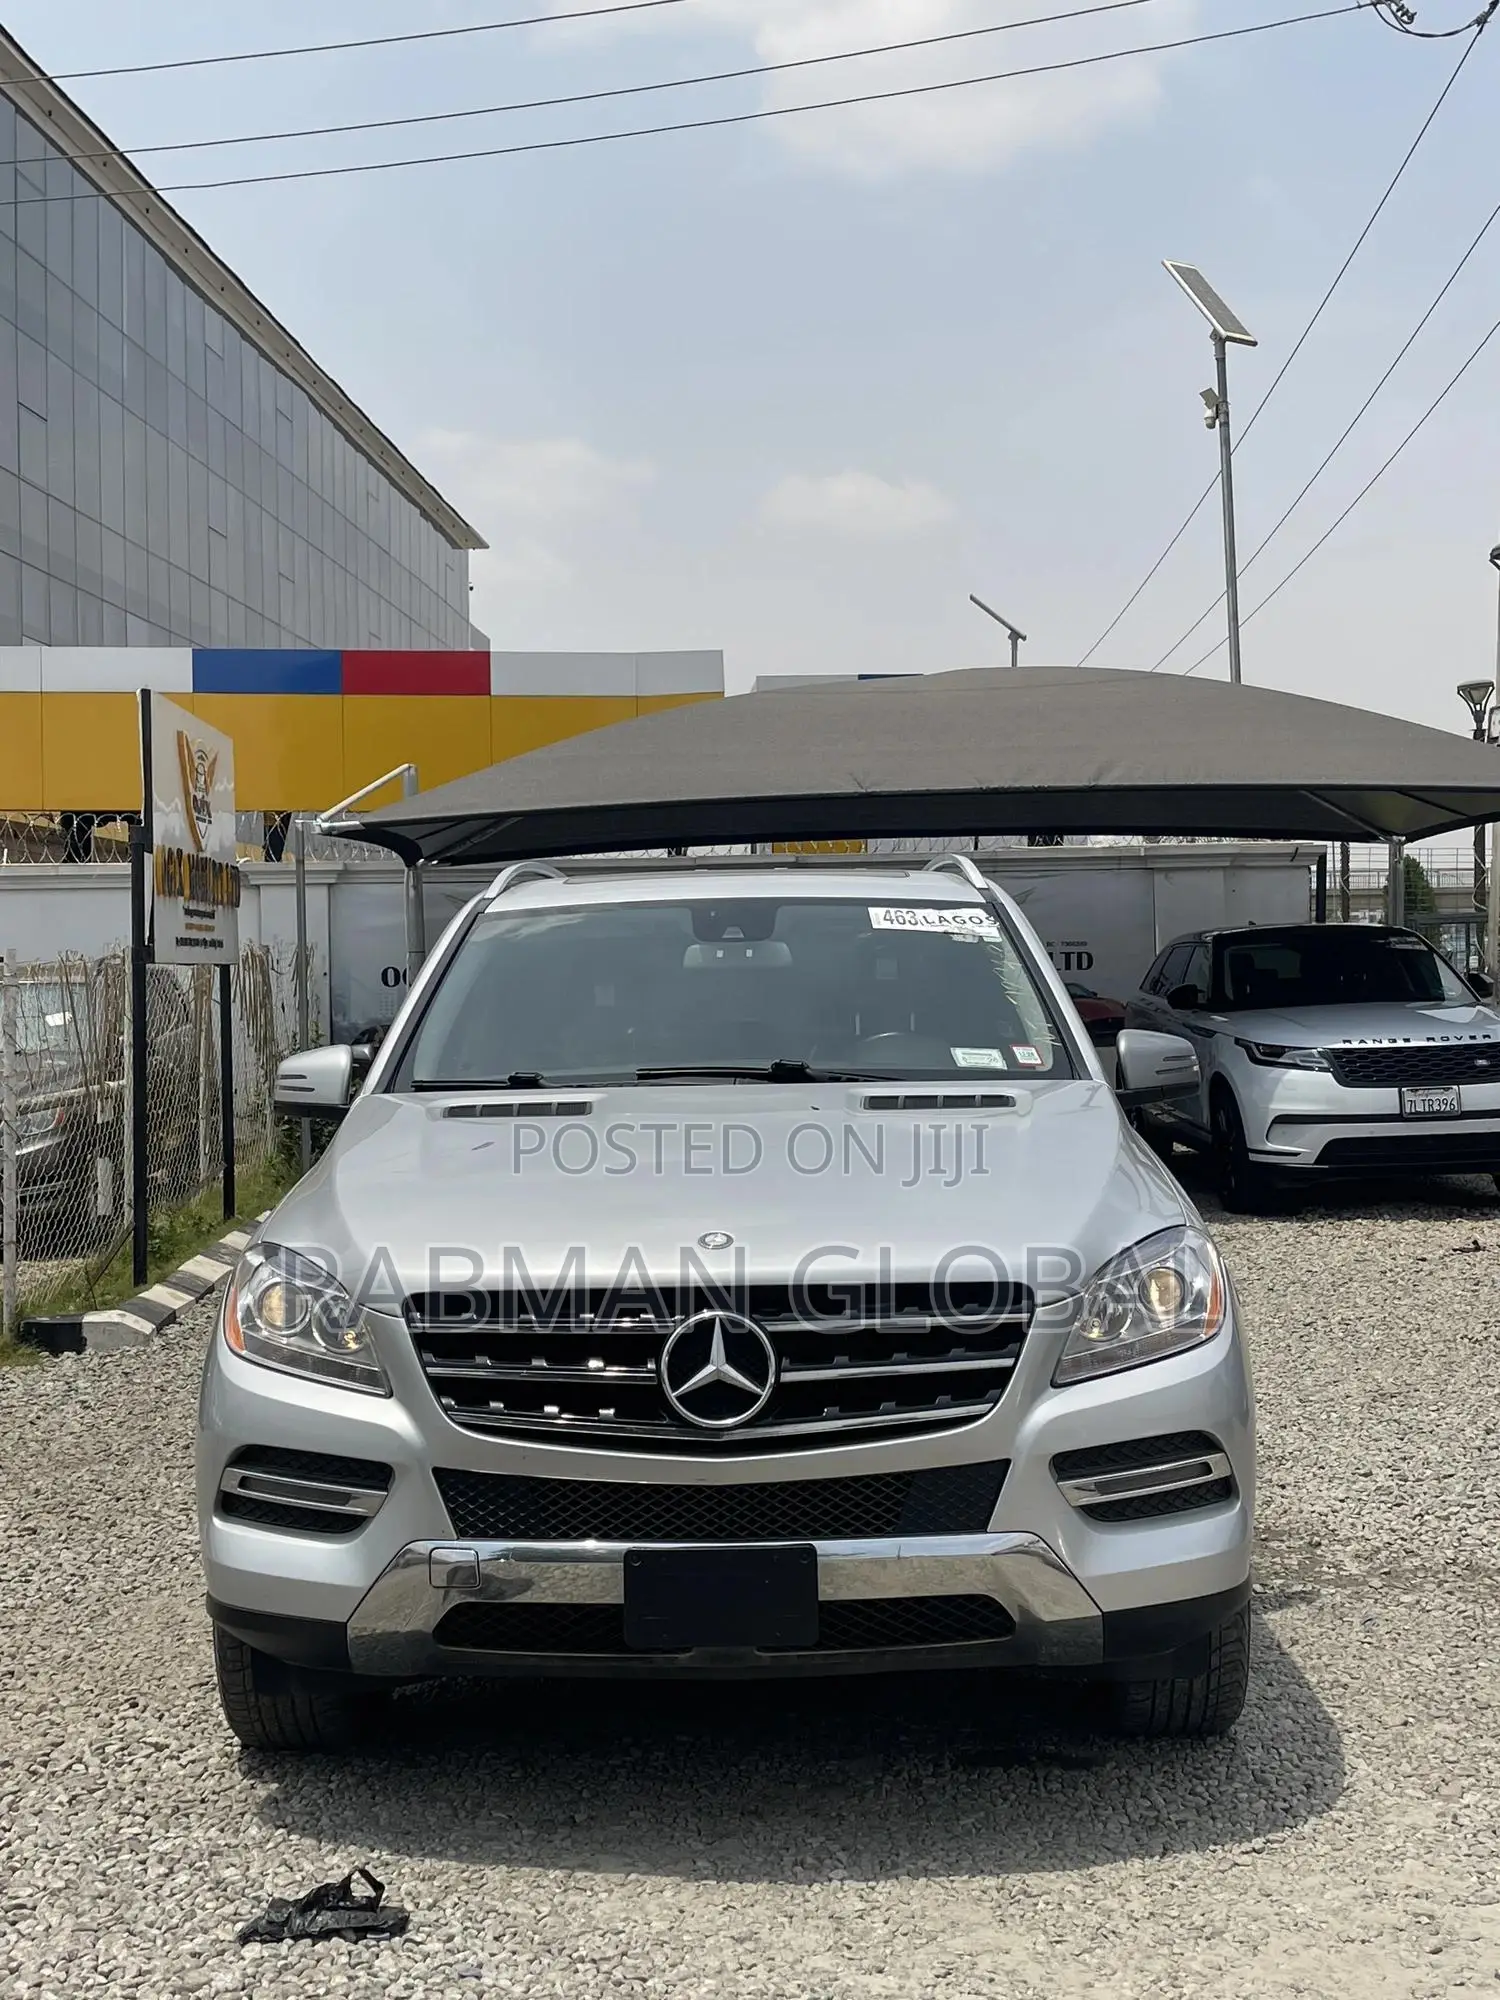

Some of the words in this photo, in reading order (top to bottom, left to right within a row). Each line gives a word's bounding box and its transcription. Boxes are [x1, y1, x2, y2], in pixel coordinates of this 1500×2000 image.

[883, 909, 919, 926] 463
[1342, 1037, 1411, 1045] RANGE
[1426, 1034, 1492, 1043] ROVER
[1407, 1097, 1456, 1114] 7LTR396
